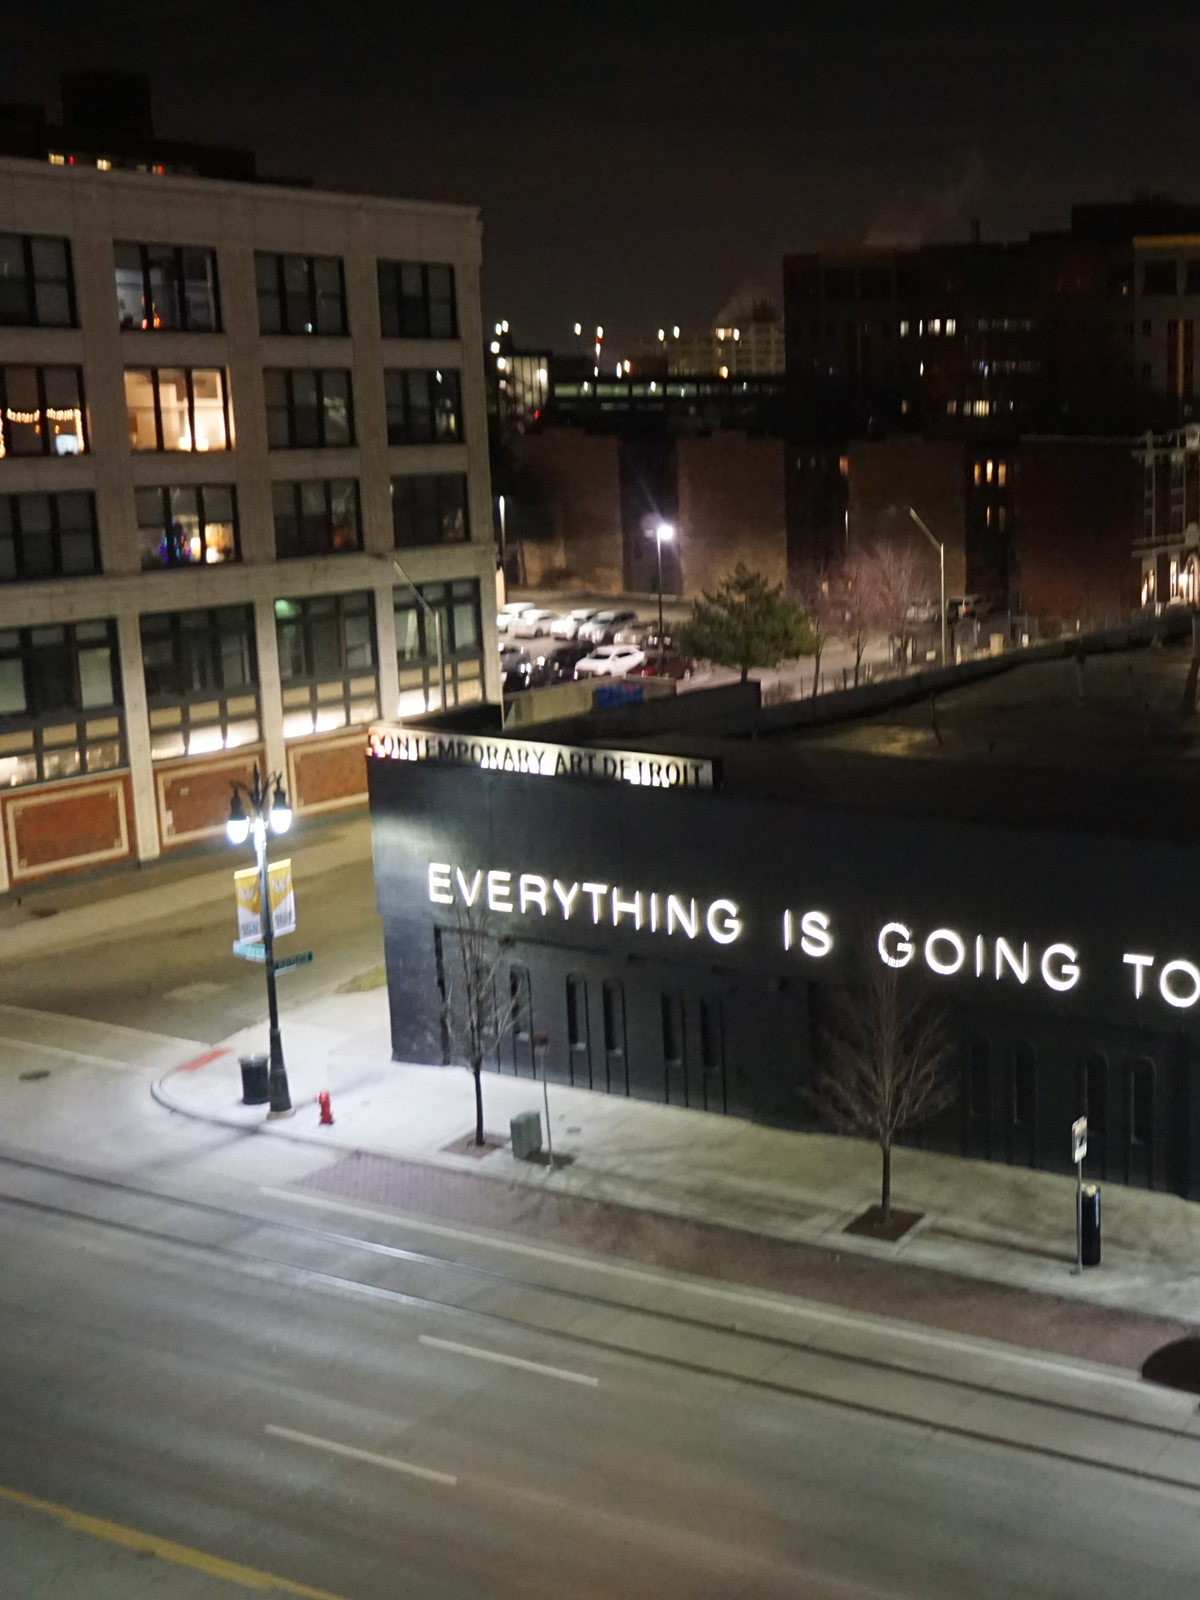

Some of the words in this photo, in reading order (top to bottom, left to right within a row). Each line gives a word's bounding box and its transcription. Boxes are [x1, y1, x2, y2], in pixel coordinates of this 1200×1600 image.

[367, 733, 547, 774] CONTEMPORARY
[555, 751, 597, 777] ART
[603, 755, 705, 788] DETROIT
[426, 862, 744, 946] EVERYTHING
[783, 908, 833, 958] IS
[877, 922, 1081, 993] GOING
